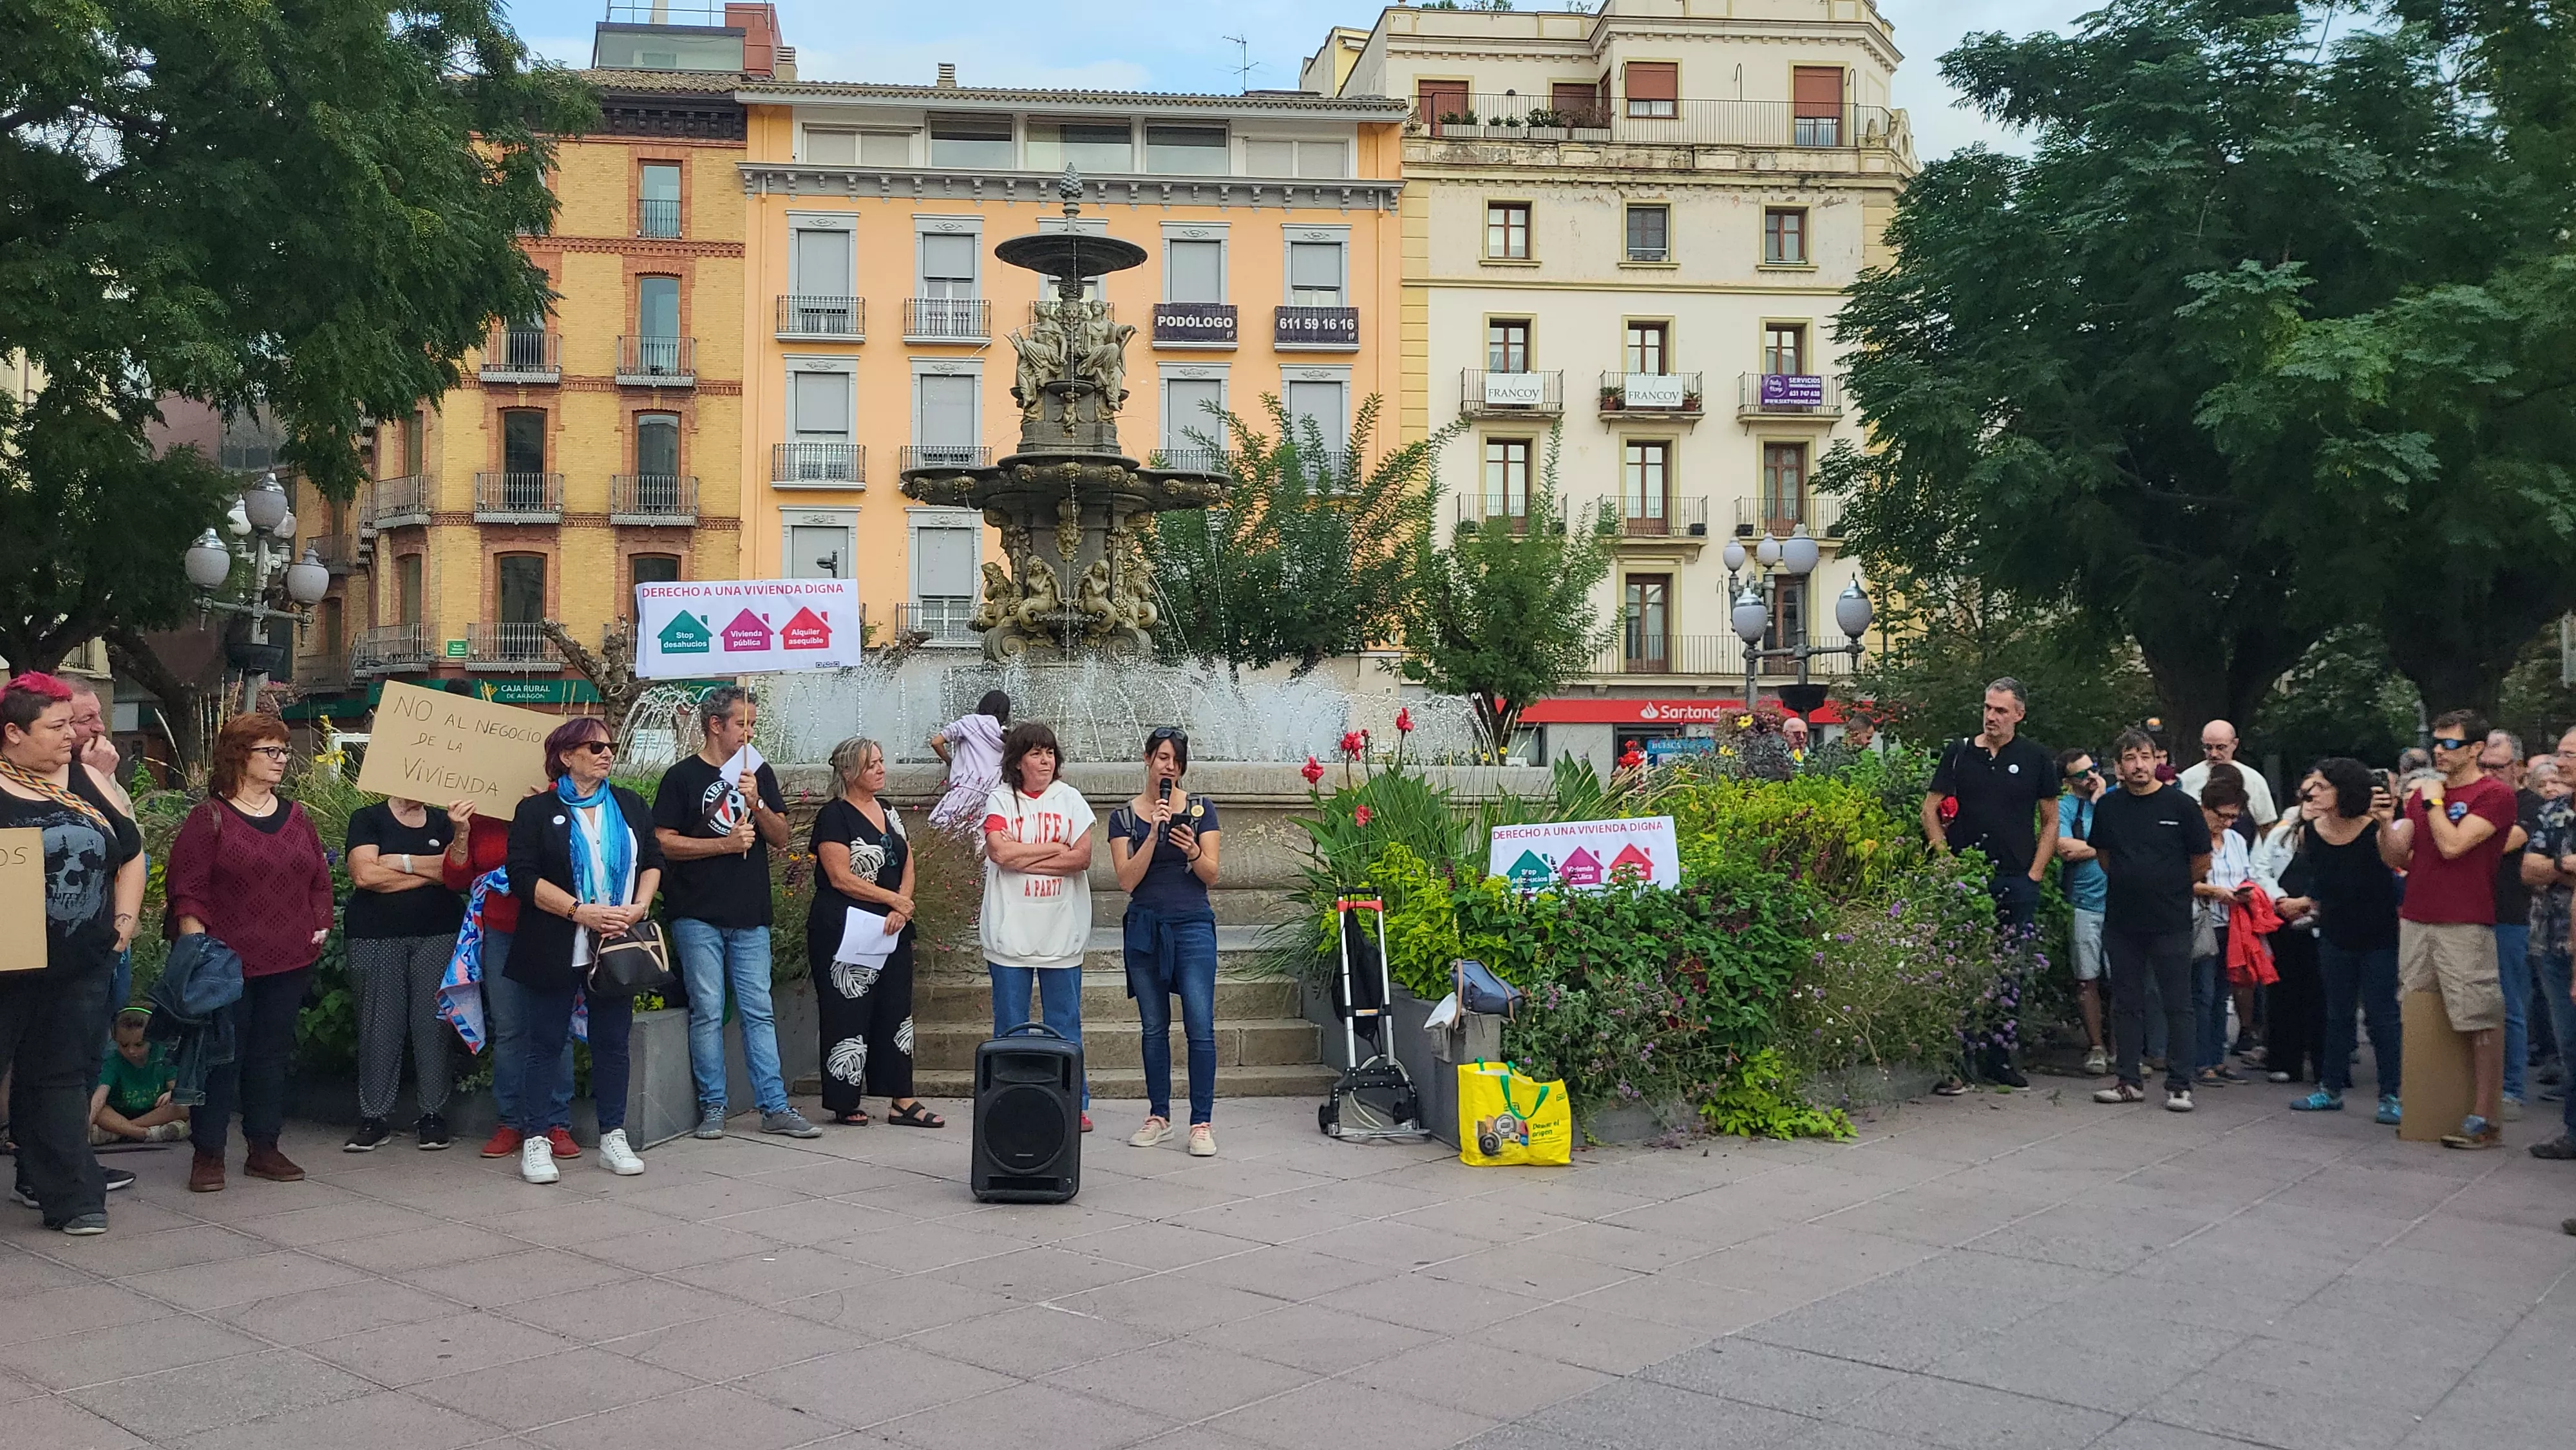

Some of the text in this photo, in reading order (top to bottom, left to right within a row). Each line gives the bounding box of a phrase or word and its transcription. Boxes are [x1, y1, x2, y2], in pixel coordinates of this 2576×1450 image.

[1157, 314, 1233, 328] PODÓLOGO
[1279, 318, 1354, 330] 611 59 16 16
[1488, 388, 1539, 400] FRANCOY
[1628, 391, 1679, 403] FRANCOY
[642, 583, 844, 598] DERECHO A UNA VIVIENDA DIGNA
[676, 632, 694, 641] Stop
[791, 628, 820, 637] Alquiler
[733, 638, 761, 648] pública
[788, 637, 824, 646] asequible
[393, 695, 433, 721] NO
[444, 713, 466, 730] AL
[1660, 705, 1720, 719] Santand
[410, 732, 463, 753] DE LA
[1032, 812, 1062, 844] IFE
[1493, 821, 1663, 840] DERECHO A UNA VIVIENDA DIGNA
[1024, 878, 1063, 897] A PARTY
